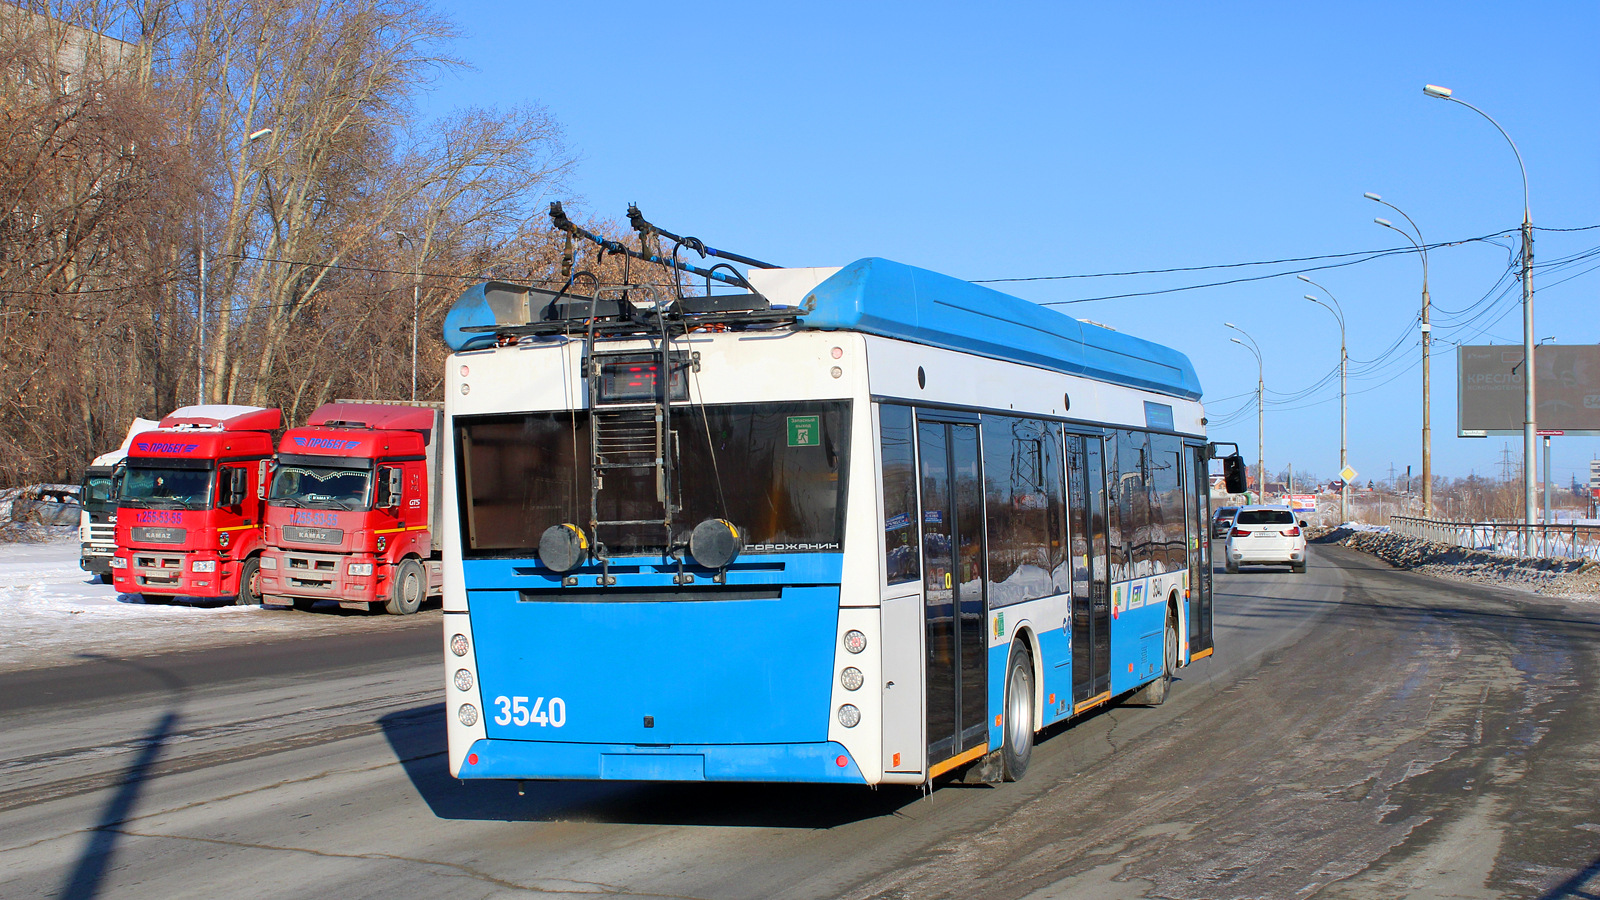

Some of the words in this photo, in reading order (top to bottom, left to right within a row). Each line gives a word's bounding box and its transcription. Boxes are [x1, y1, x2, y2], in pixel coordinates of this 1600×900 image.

[1467, 373, 1522, 384] КРЕСЛО
[150, 443, 186, 453] ПРОБЕГ
[307, 438, 347, 449] ПРОБЕГ
[409, 498, 421, 506] GTS
[298, 532, 326, 540] KAMAZ
[494, 695, 566, 728] 3540
